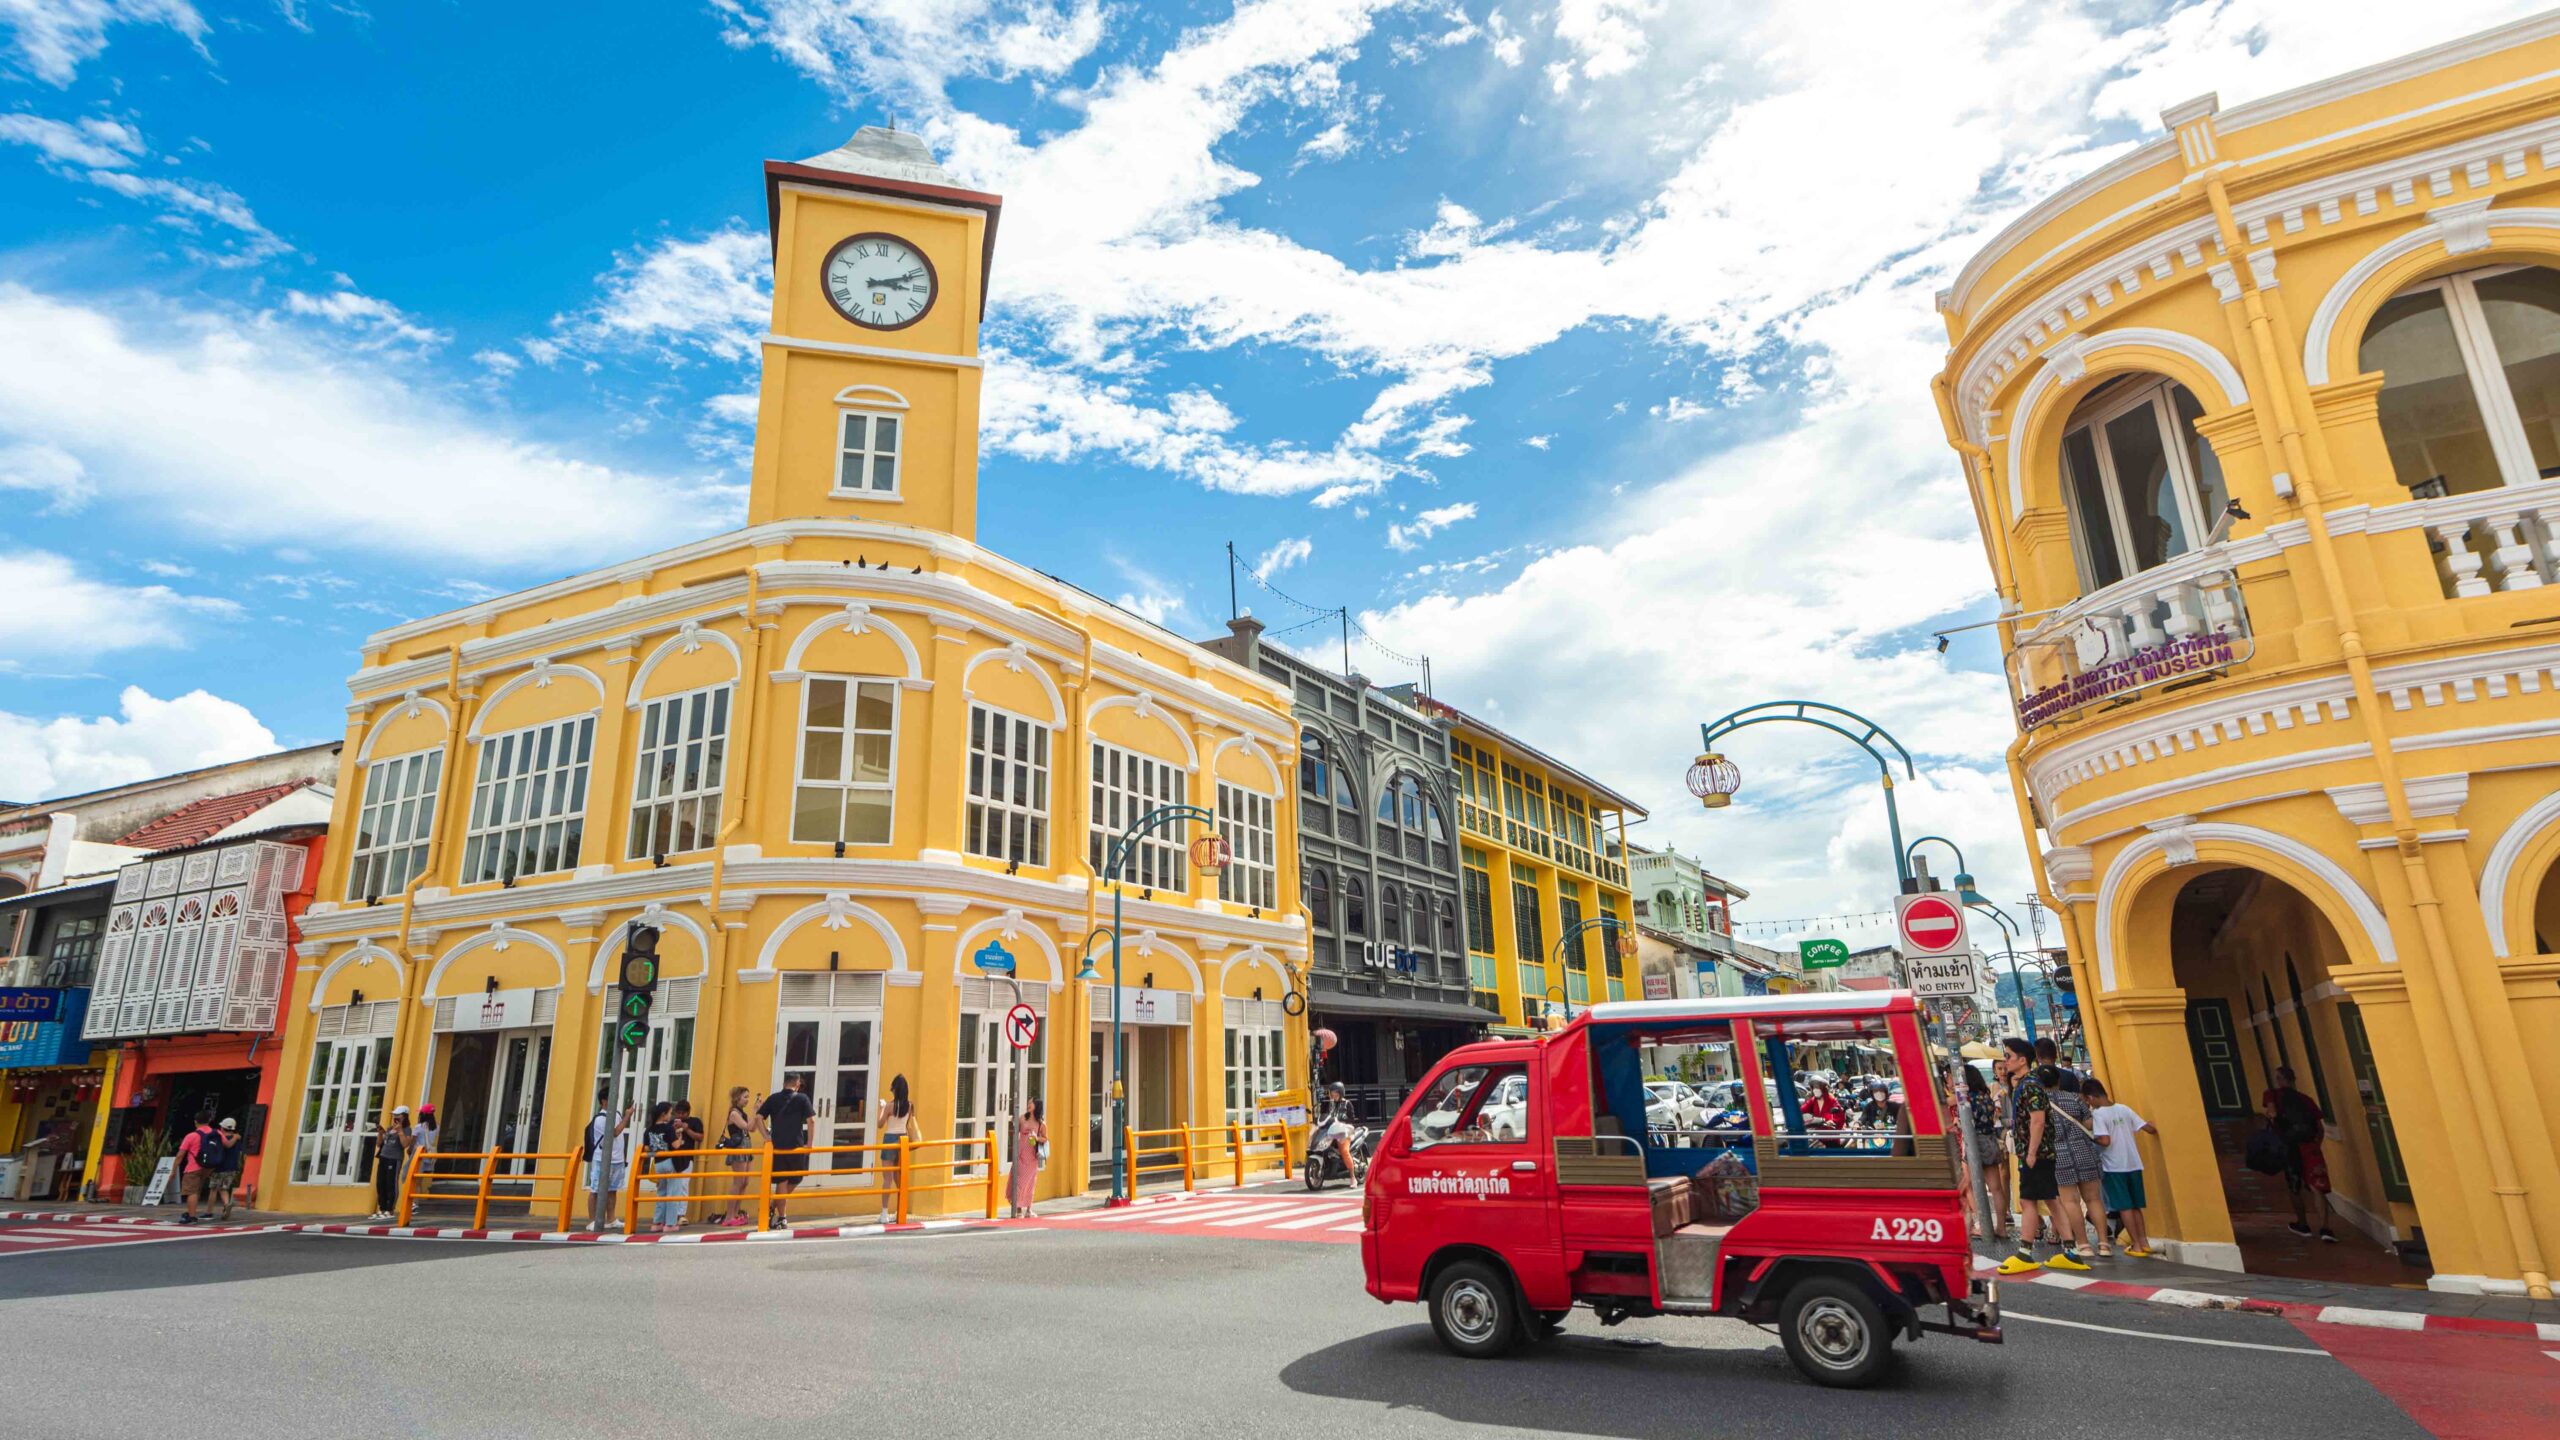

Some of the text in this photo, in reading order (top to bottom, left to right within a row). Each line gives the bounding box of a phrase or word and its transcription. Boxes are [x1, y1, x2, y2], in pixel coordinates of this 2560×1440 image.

[855, 244, 870, 260] XI
[875, 243, 889, 258] XII
[896, 252, 907, 263] I
[838, 255, 854, 269] X
[832, 273, 848, 285] IX
[834, 287, 852, 305] VIII
[912, 284, 928, 294] III
[849, 302, 866, 321] VII
[872, 311, 884, 325] VI
[894, 310, 906, 324] V
[2022, 645, 2234, 728] PERANAKANNITAT MUSEUM
[1806, 943, 1843, 958] COMFEE
[1911, 958, 1970, 979] ห้ามเข้า
[1919, 982, 1966, 992] NO ENTRY
[1408, 1169, 1510, 1201] เขตจังหวัดภูเก็ต
[1870, 1217, 1943, 1243] A229
